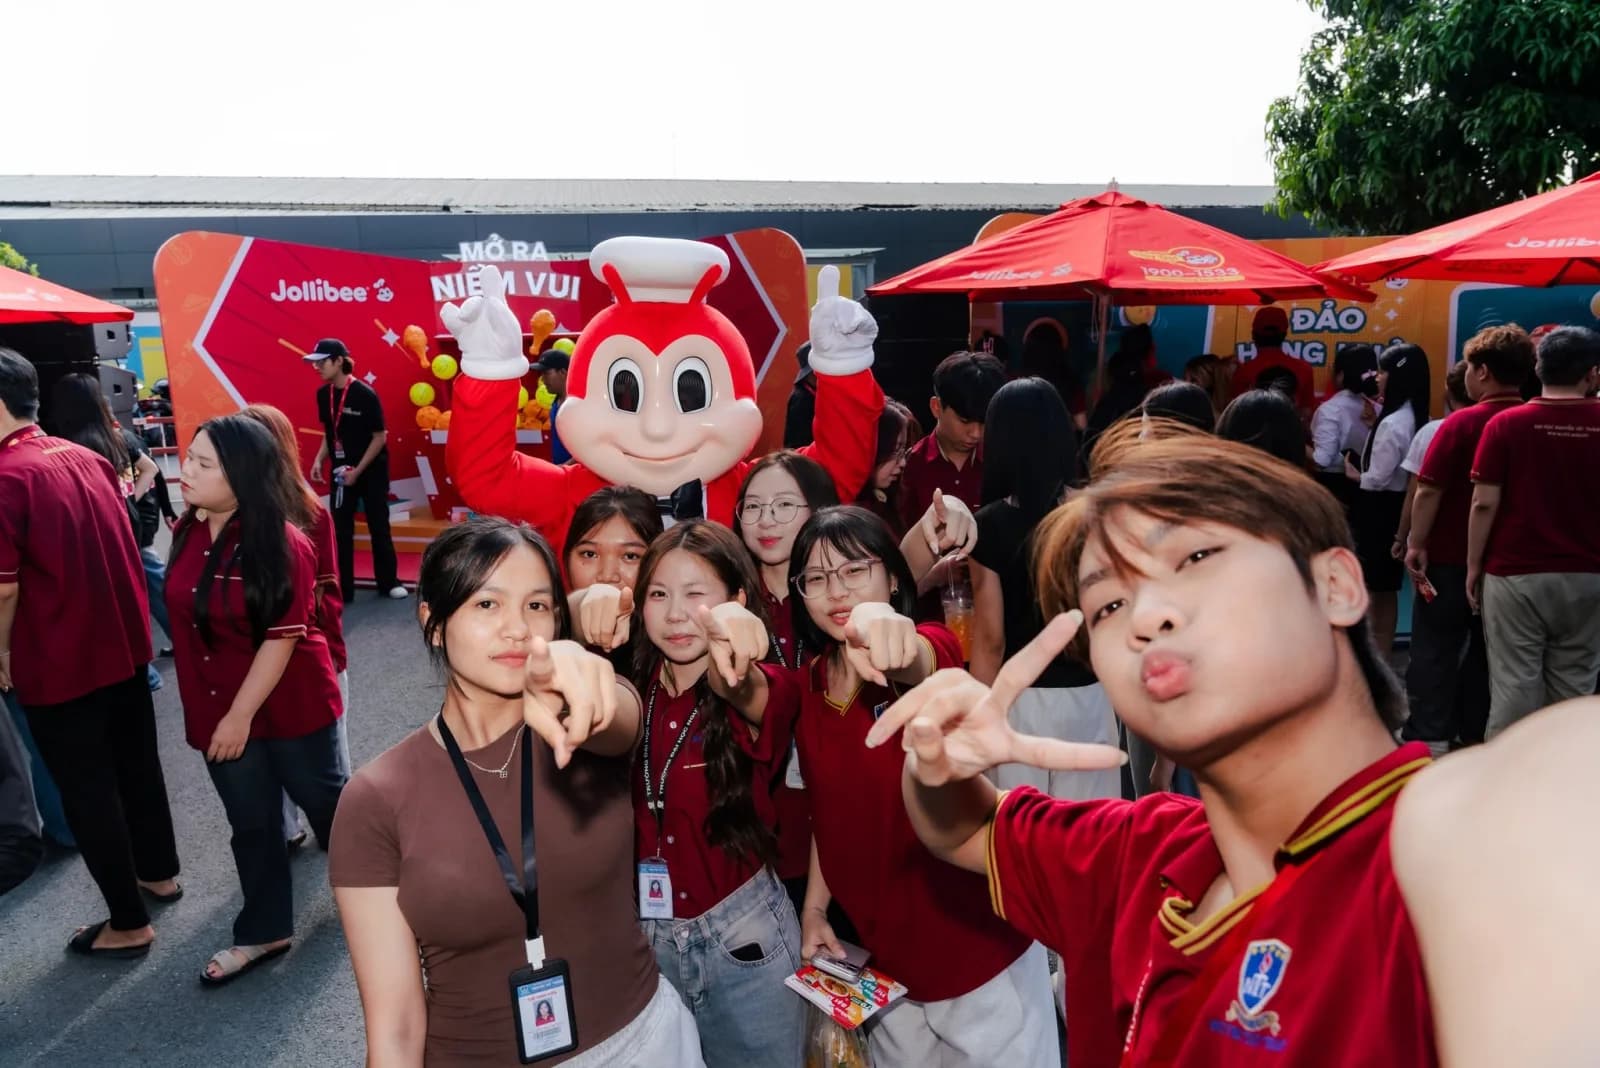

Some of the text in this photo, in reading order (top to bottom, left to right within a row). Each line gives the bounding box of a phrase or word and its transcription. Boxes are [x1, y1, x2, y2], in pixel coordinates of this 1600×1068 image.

[458, 232, 548, 261] MỞ RA
[1505, 236, 1600, 248] Jollib
[270, 278, 368, 302] Jollibee
[525, 271, 581, 302] VUI
[1292, 301, 1365, 331] ĐẢO
[1236, 341, 1326, 365] HNG
